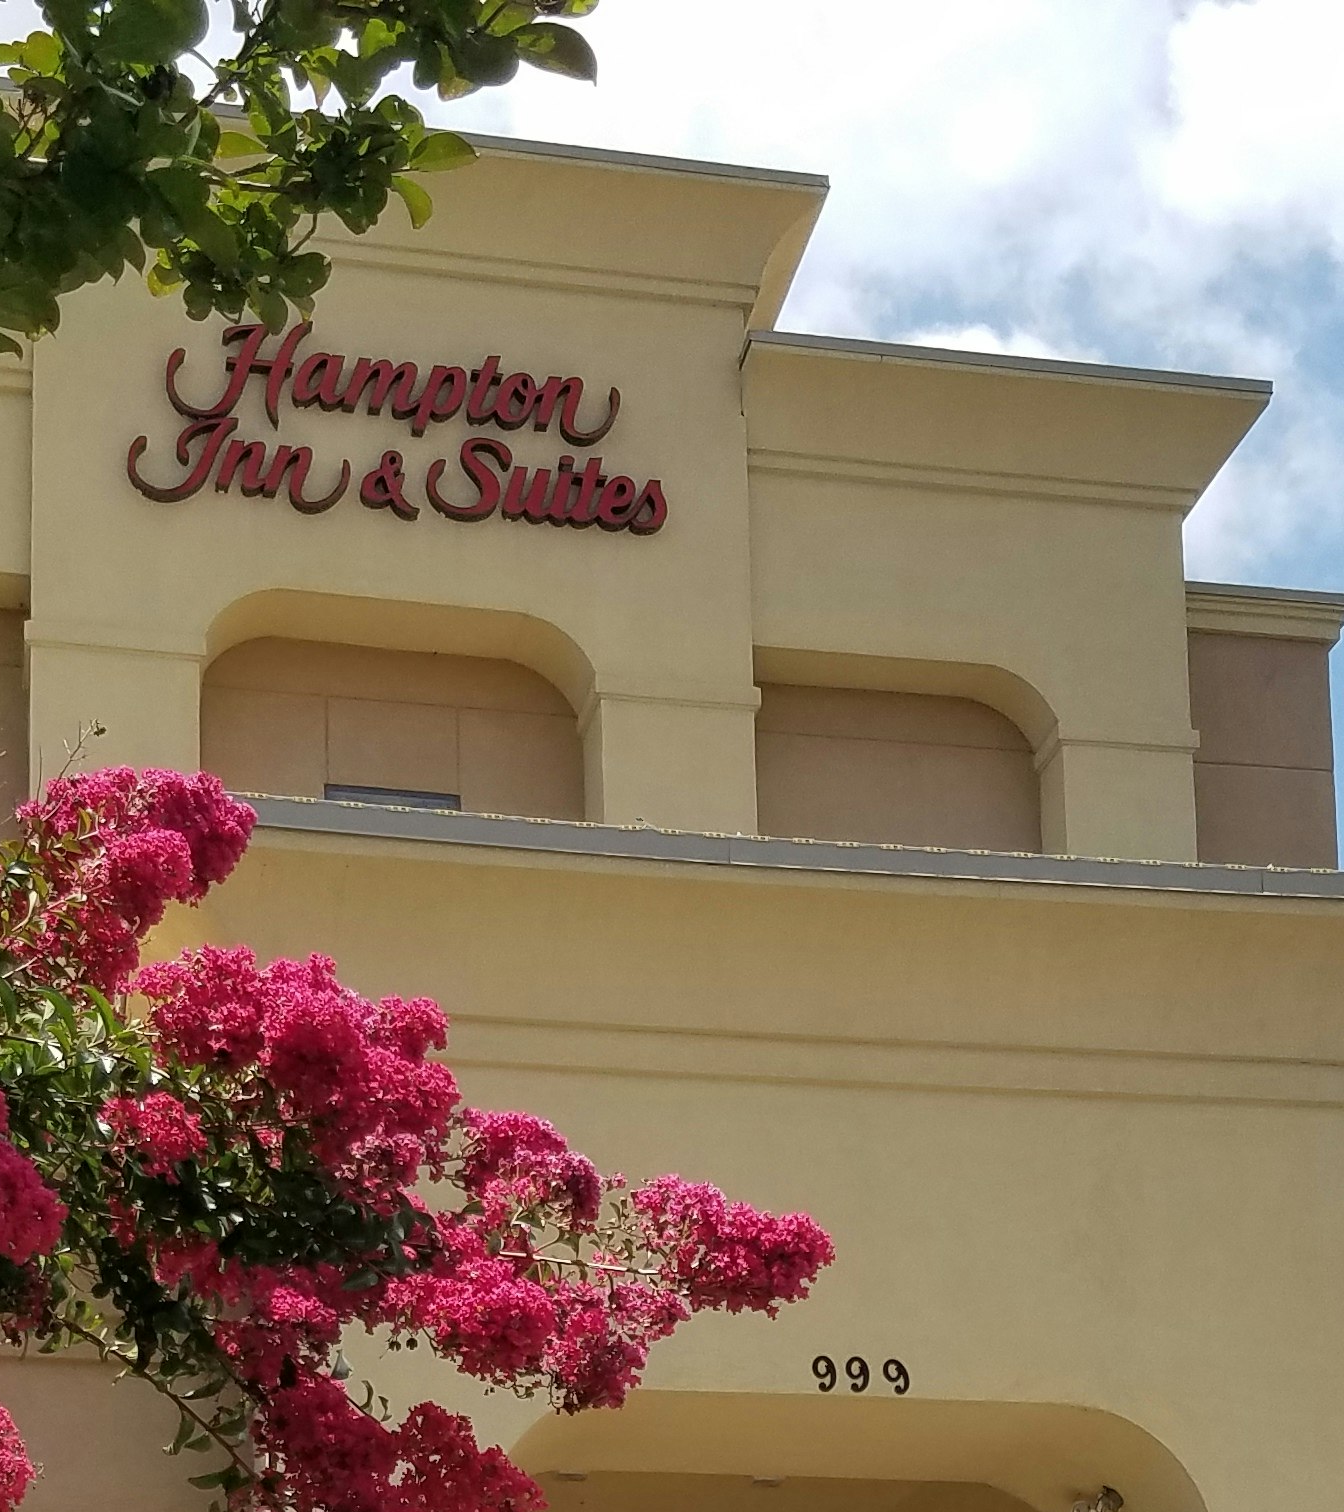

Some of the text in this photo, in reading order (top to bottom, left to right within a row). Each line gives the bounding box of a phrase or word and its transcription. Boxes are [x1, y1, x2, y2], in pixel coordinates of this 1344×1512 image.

[166, 320, 621, 447] Hampton
[127, 416, 668, 536] Inn & Suites
[811, 1355, 910, 1395] 999
